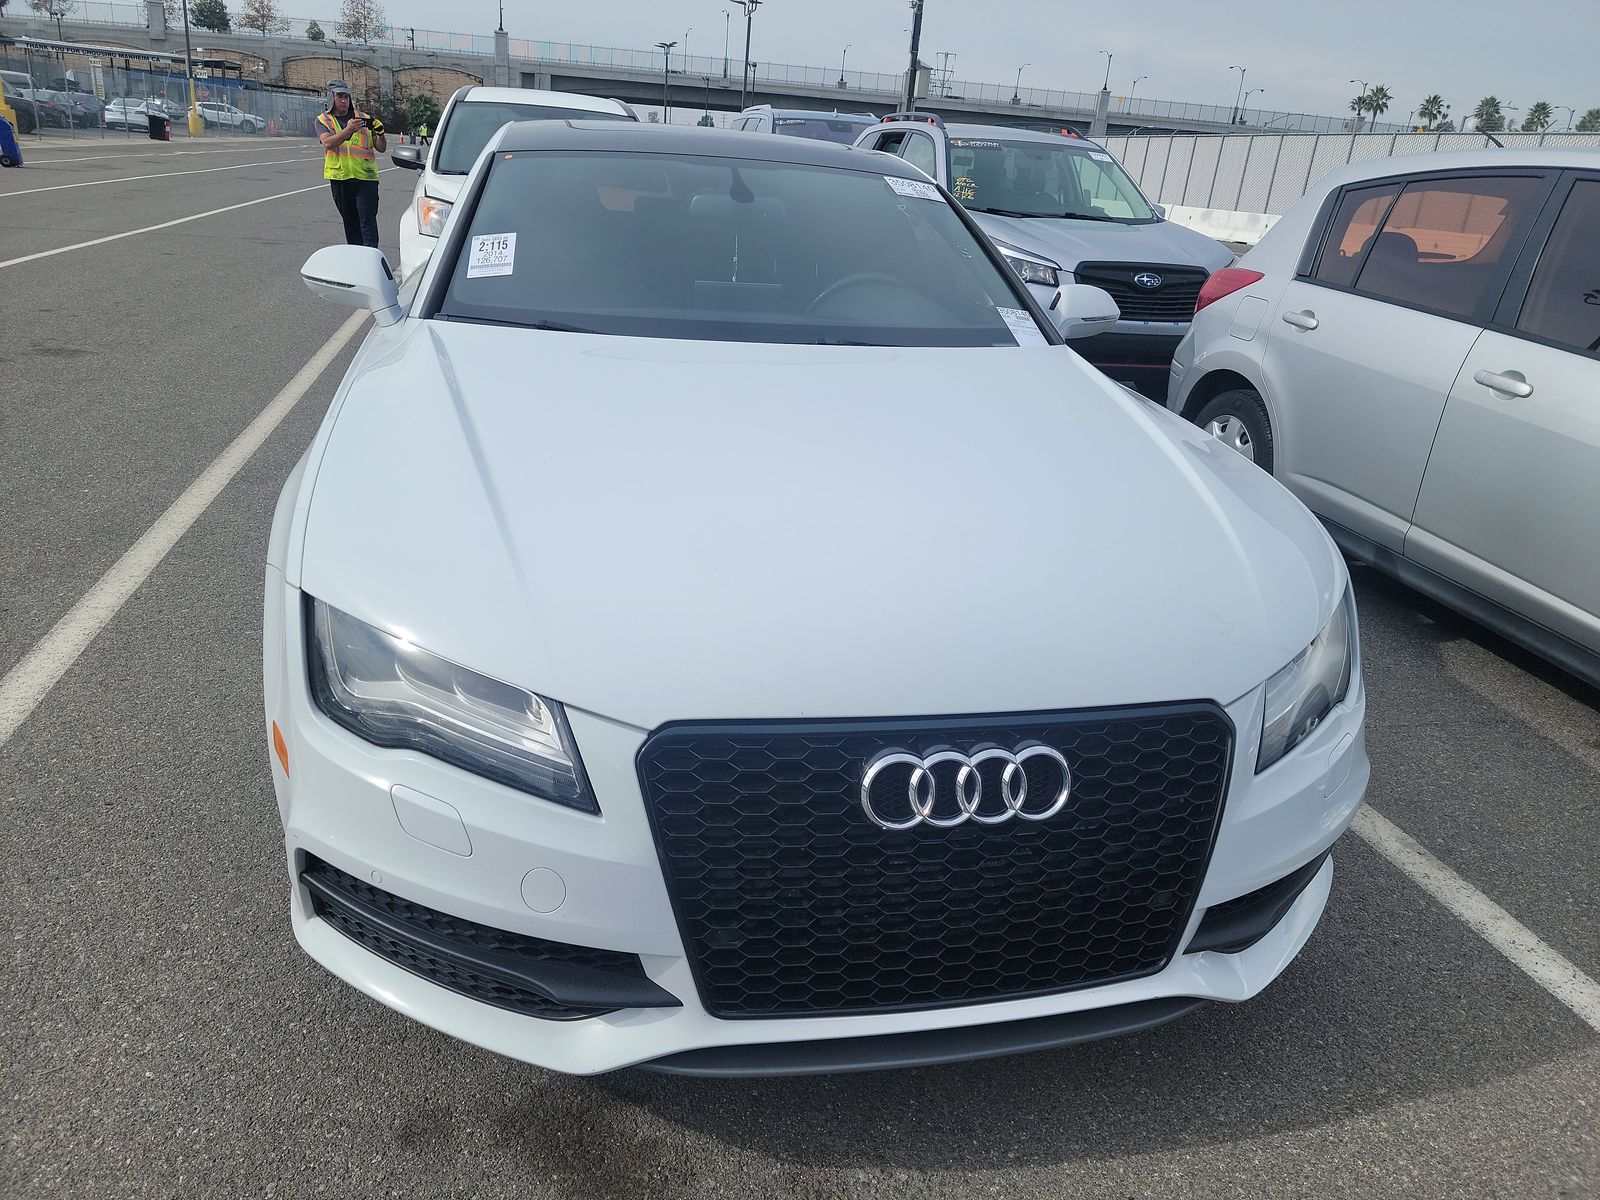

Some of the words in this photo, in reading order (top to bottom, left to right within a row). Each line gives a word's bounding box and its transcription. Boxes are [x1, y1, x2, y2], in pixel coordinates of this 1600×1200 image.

[82, 50, 117, 58] CHOOSING
[119, 53, 149, 61] MANHEIM
[888, 178, 936, 192] 3508140
[479, 240, 508, 251] 2:115
[477, 255, 508, 264] 126,707
